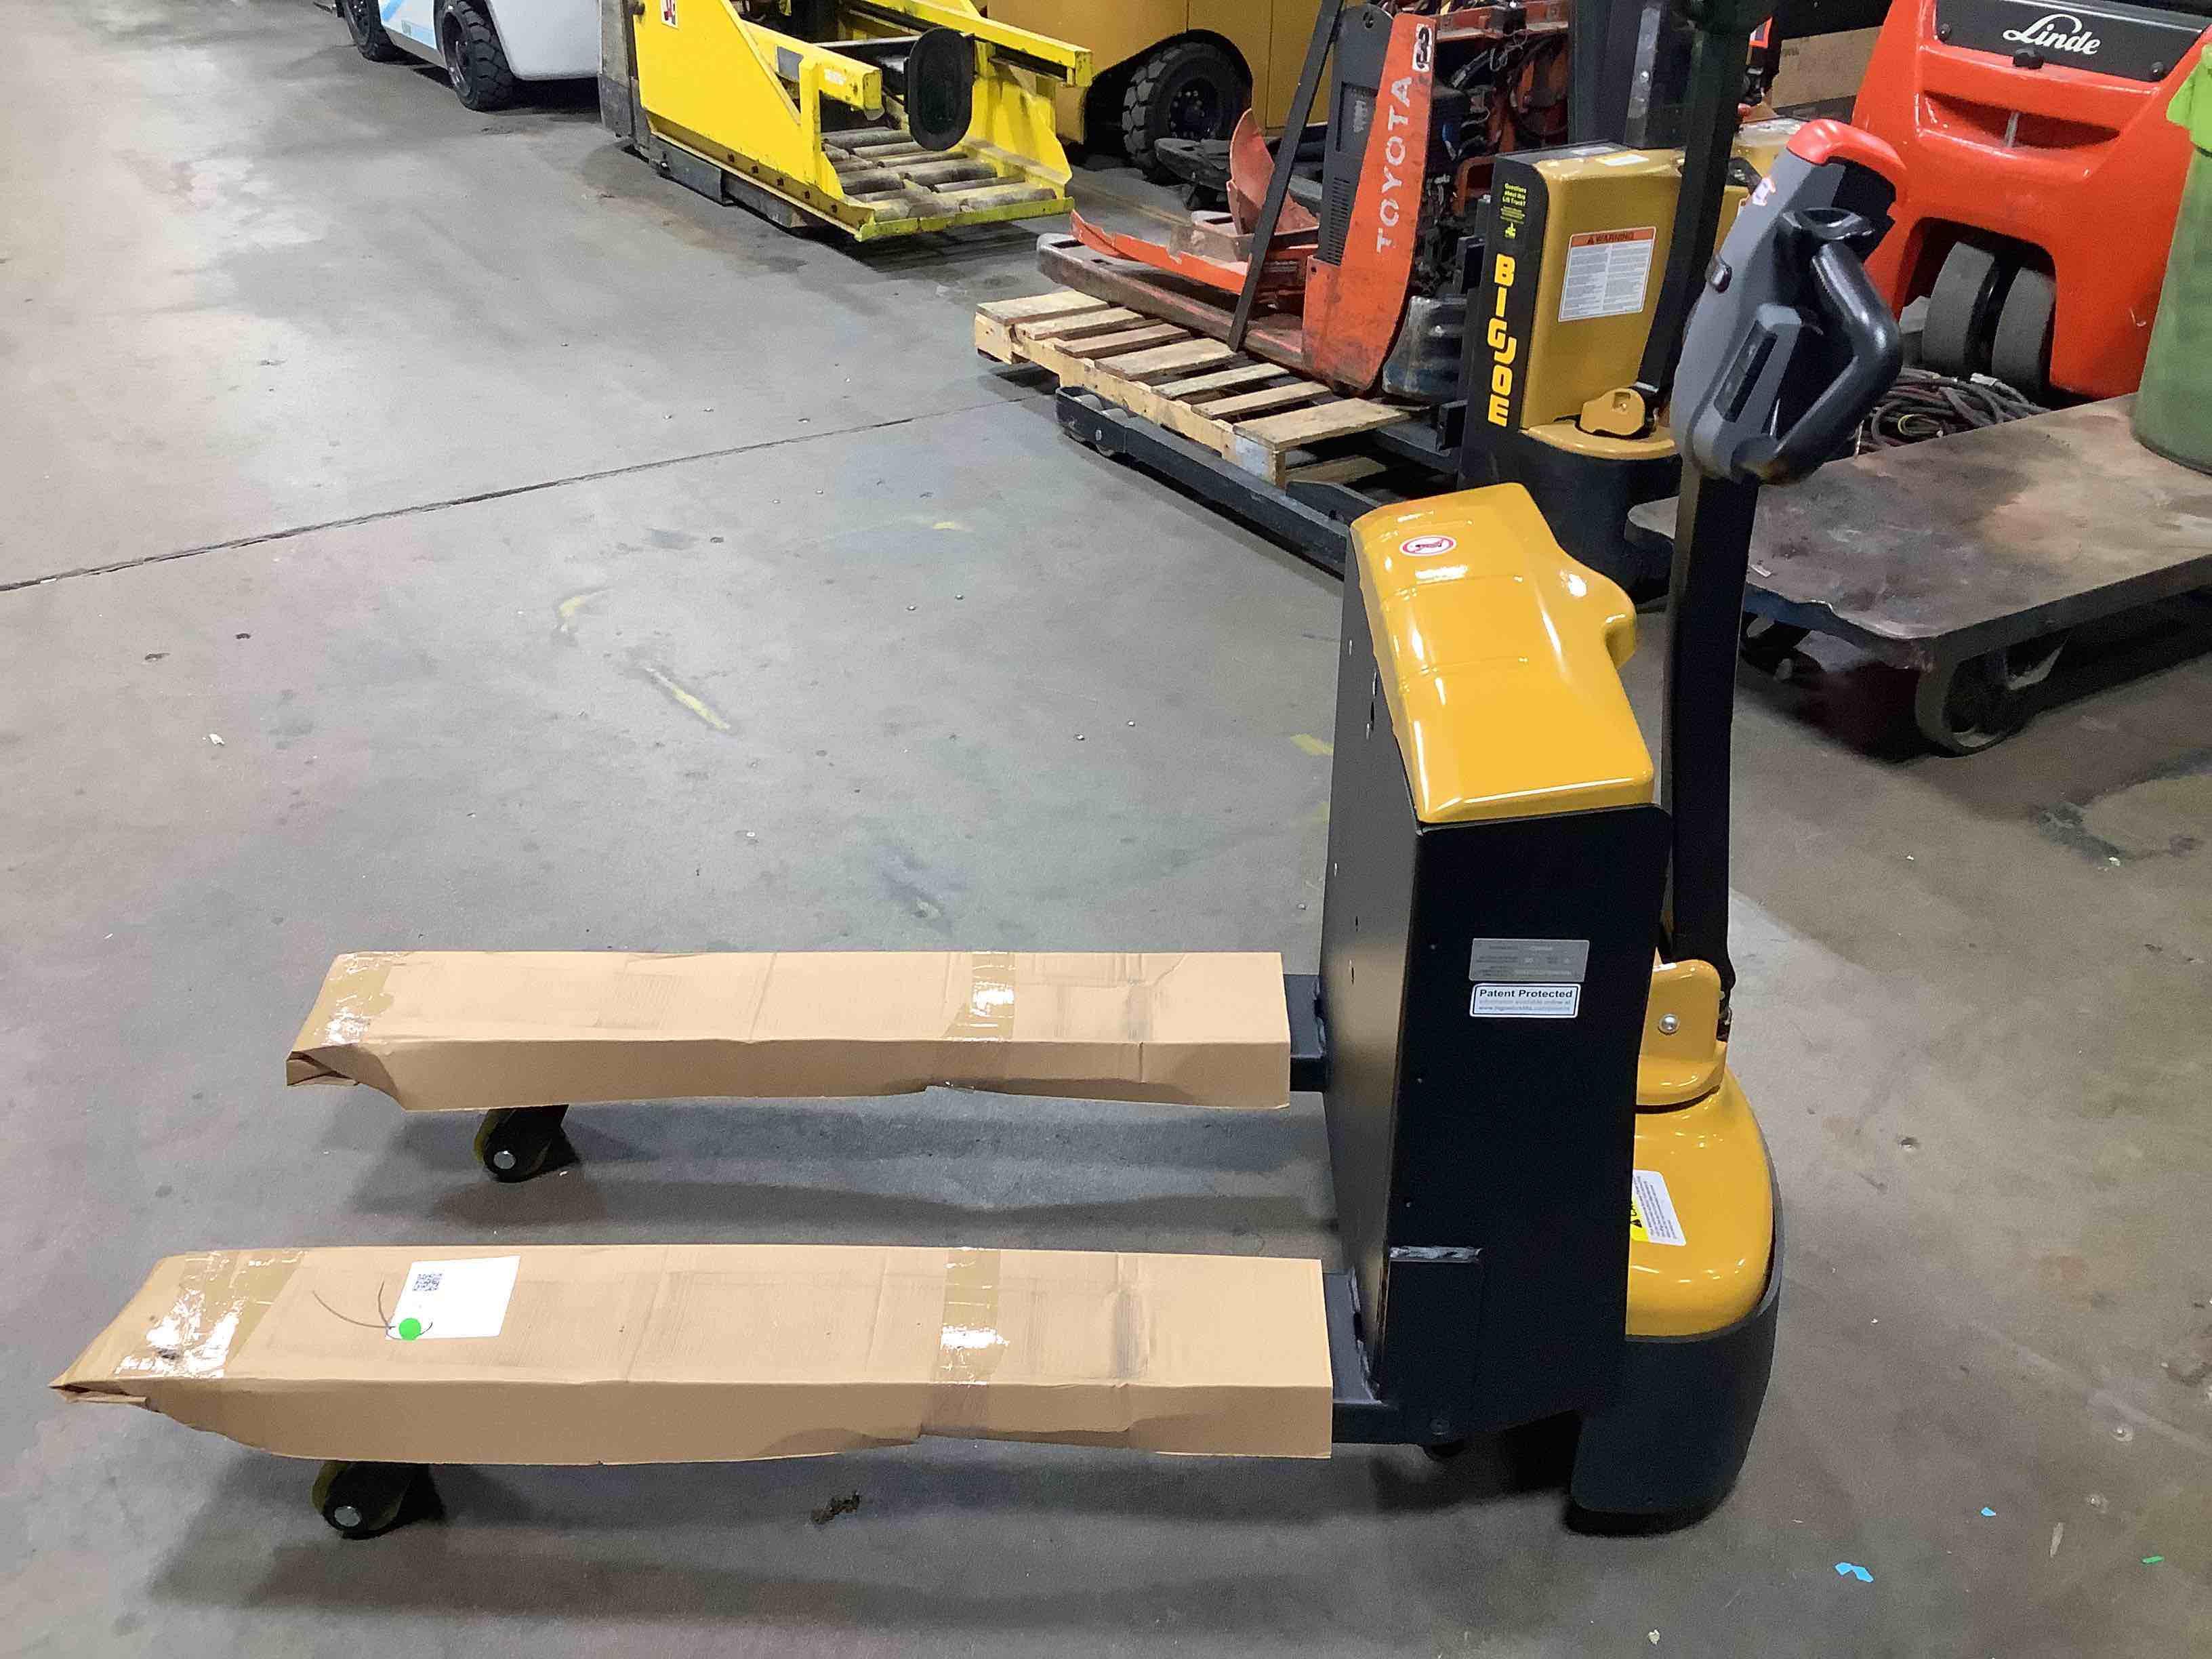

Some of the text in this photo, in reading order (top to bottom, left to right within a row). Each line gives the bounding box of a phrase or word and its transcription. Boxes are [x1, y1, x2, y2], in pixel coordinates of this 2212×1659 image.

[2003, 14, 2102, 55] Linde
[1376, 76, 1413, 254] TOYOTA
[1594, 232, 1634, 243] WARNING
[1479, 989, 1572, 998] Patent Protected
